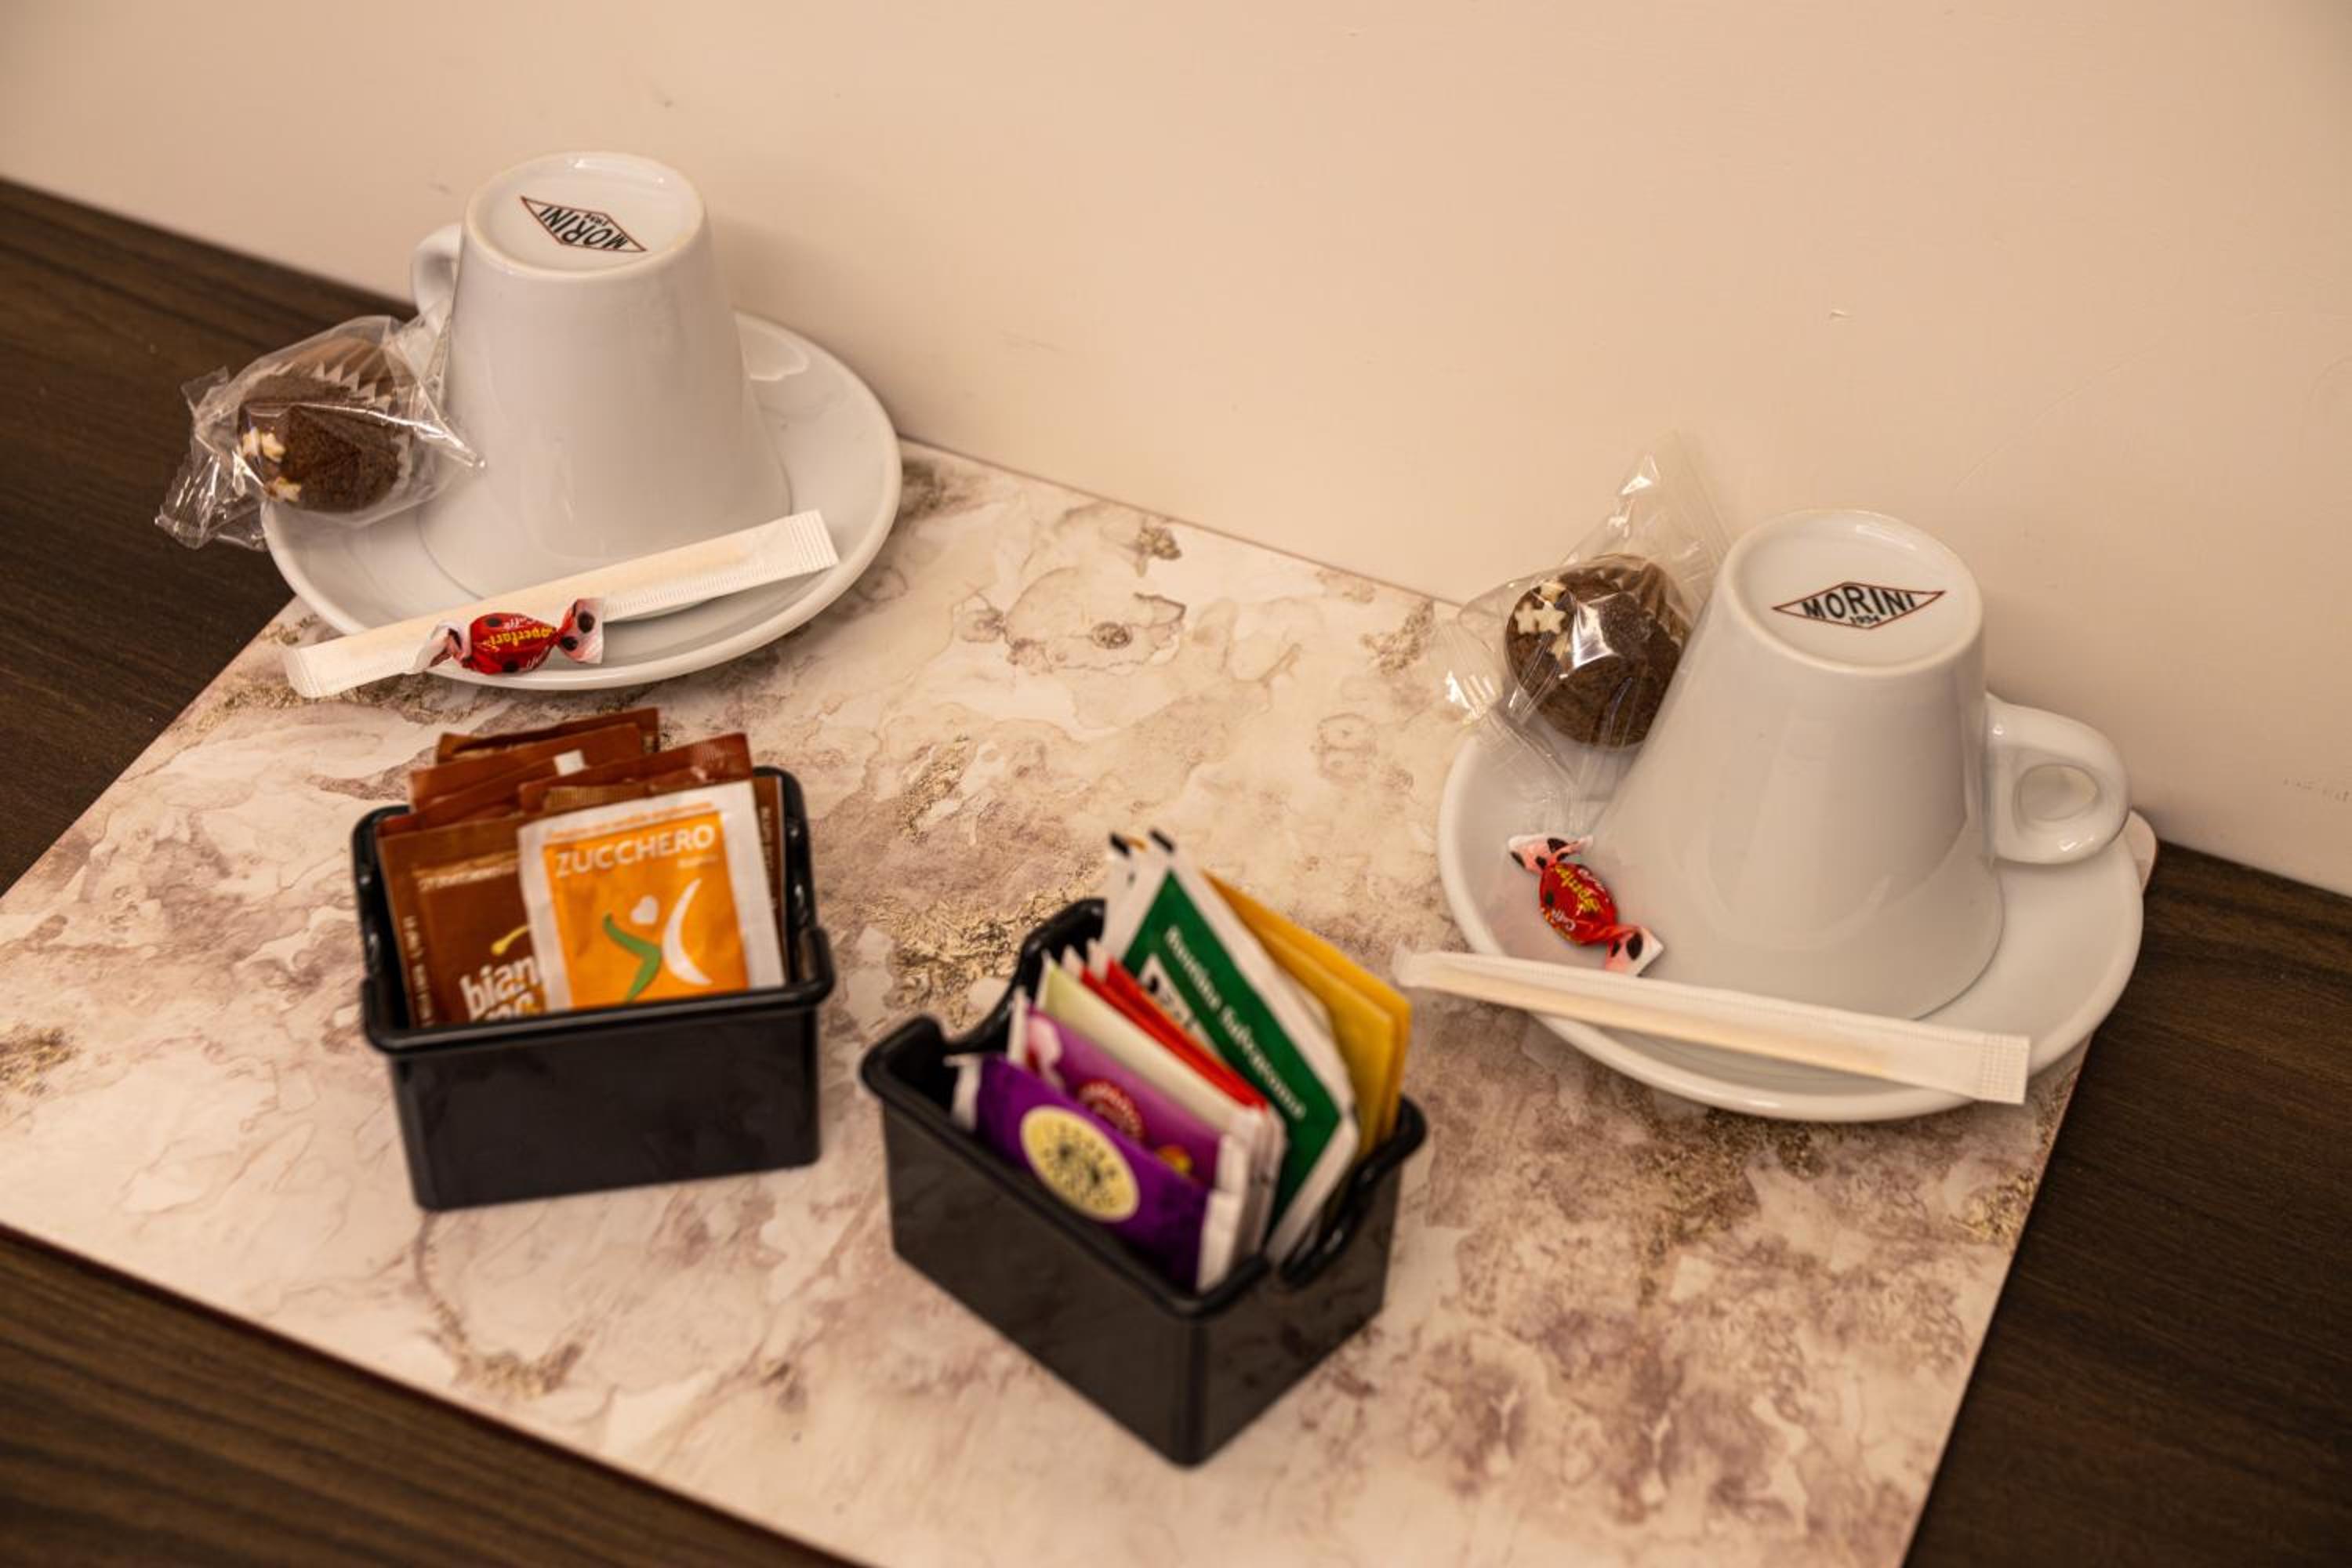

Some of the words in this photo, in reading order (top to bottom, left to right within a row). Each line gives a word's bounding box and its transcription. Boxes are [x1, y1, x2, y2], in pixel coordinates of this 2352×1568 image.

[539, 205, 628, 249] MORINI
[1802, 585, 1916, 619] MORINI
[555, 824, 716, 878] ZUCCHERO
